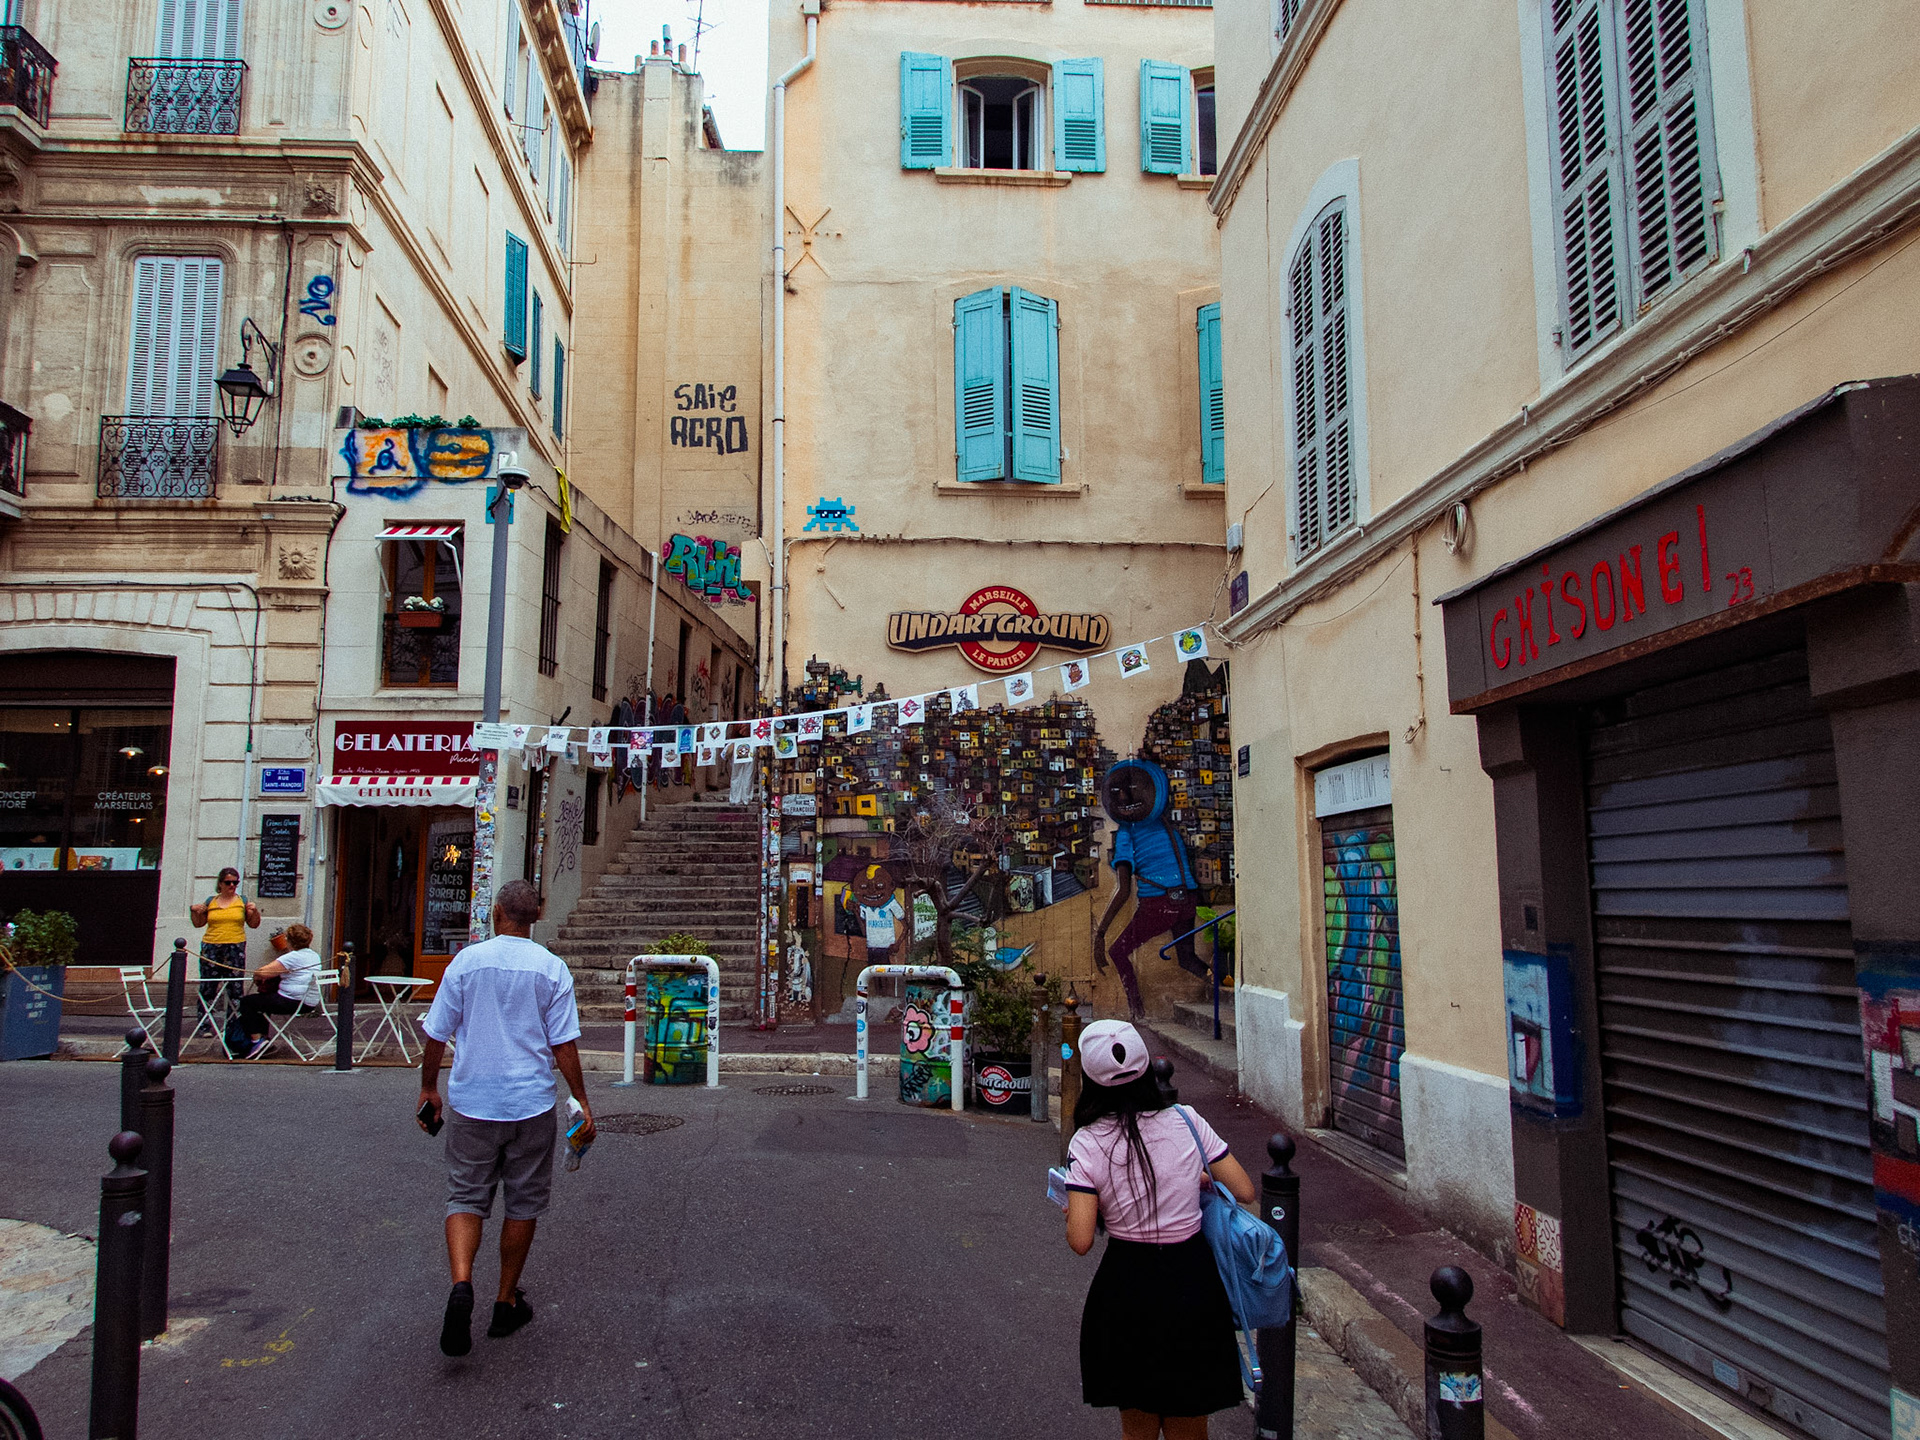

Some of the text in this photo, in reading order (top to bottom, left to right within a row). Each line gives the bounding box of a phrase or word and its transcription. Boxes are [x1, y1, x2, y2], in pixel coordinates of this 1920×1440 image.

[969, 590, 1028, 610] MARSEILLE
[889, 613, 1108, 645] UNDARTGROUND
[972, 649, 1026, 667] LE PANIER
[335, 733, 481, 751] GELATERIA
[97, 791, 152, 800] CRÉATEURS
[358, 788, 432, 797] GELATERIA
[94, 801, 153, 809] MARSEILLAIS
[430, 873, 463, 886] GLACES
[428, 887, 467, 901] SORBETS
